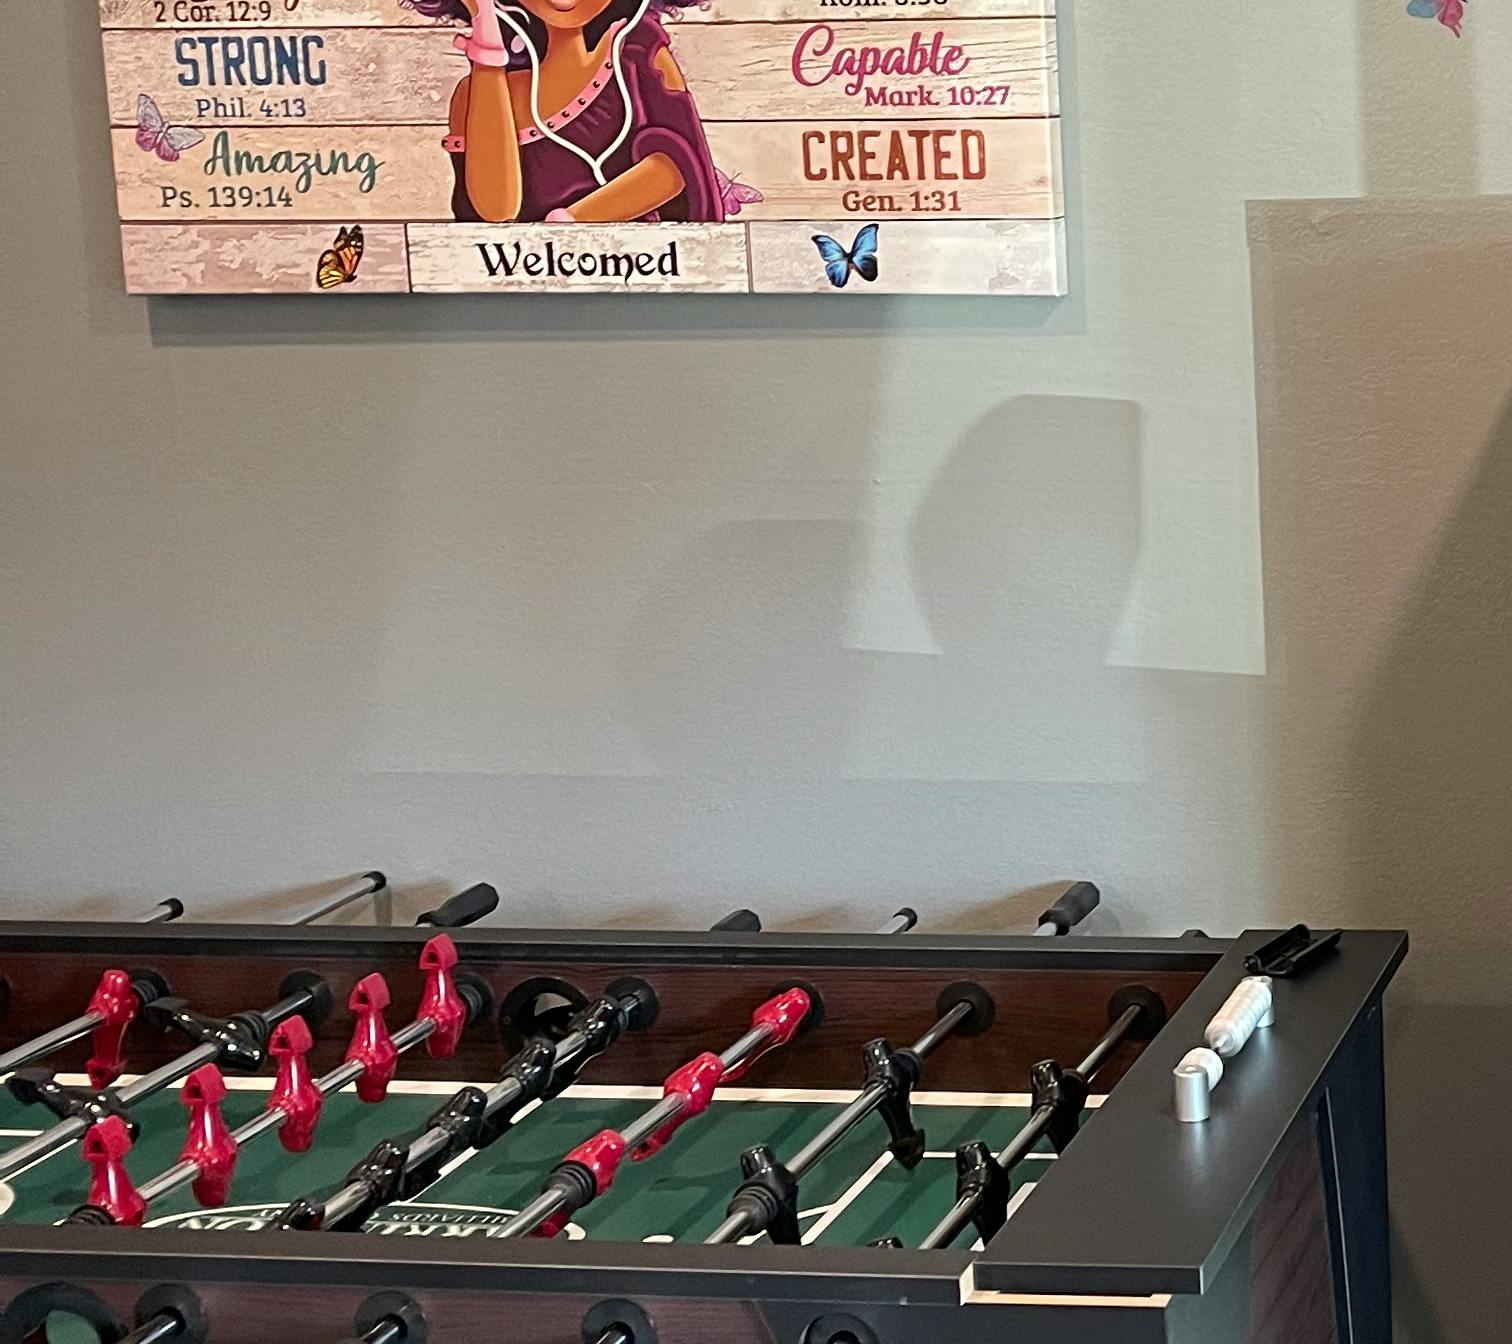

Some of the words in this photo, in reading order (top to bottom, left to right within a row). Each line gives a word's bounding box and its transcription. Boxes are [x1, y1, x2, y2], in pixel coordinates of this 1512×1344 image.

[154, 2, 166, 24] 2
[173, 2, 221, 24] Cor.
[228, 1, 272, 23] 12:9
[175, 34, 326, 88] STRONG
[791, 25, 971, 99] Capable
[196, 97, 253, 121] Phil.
[261, 96, 307, 119] 4:13
[864, 86, 939, 108] Mark.
[946, 84, 1011, 107] 10:27
[203, 128, 385, 192] Amazing
[803, 128, 986, 184] CREATED
[160, 187, 199, 210] Ps.
[207, 186, 293, 209] 139:14
[841, 190, 900, 213] Gen.
[908, 189, 962, 212] 1:31
[476, 241, 680, 287] Welcomed
